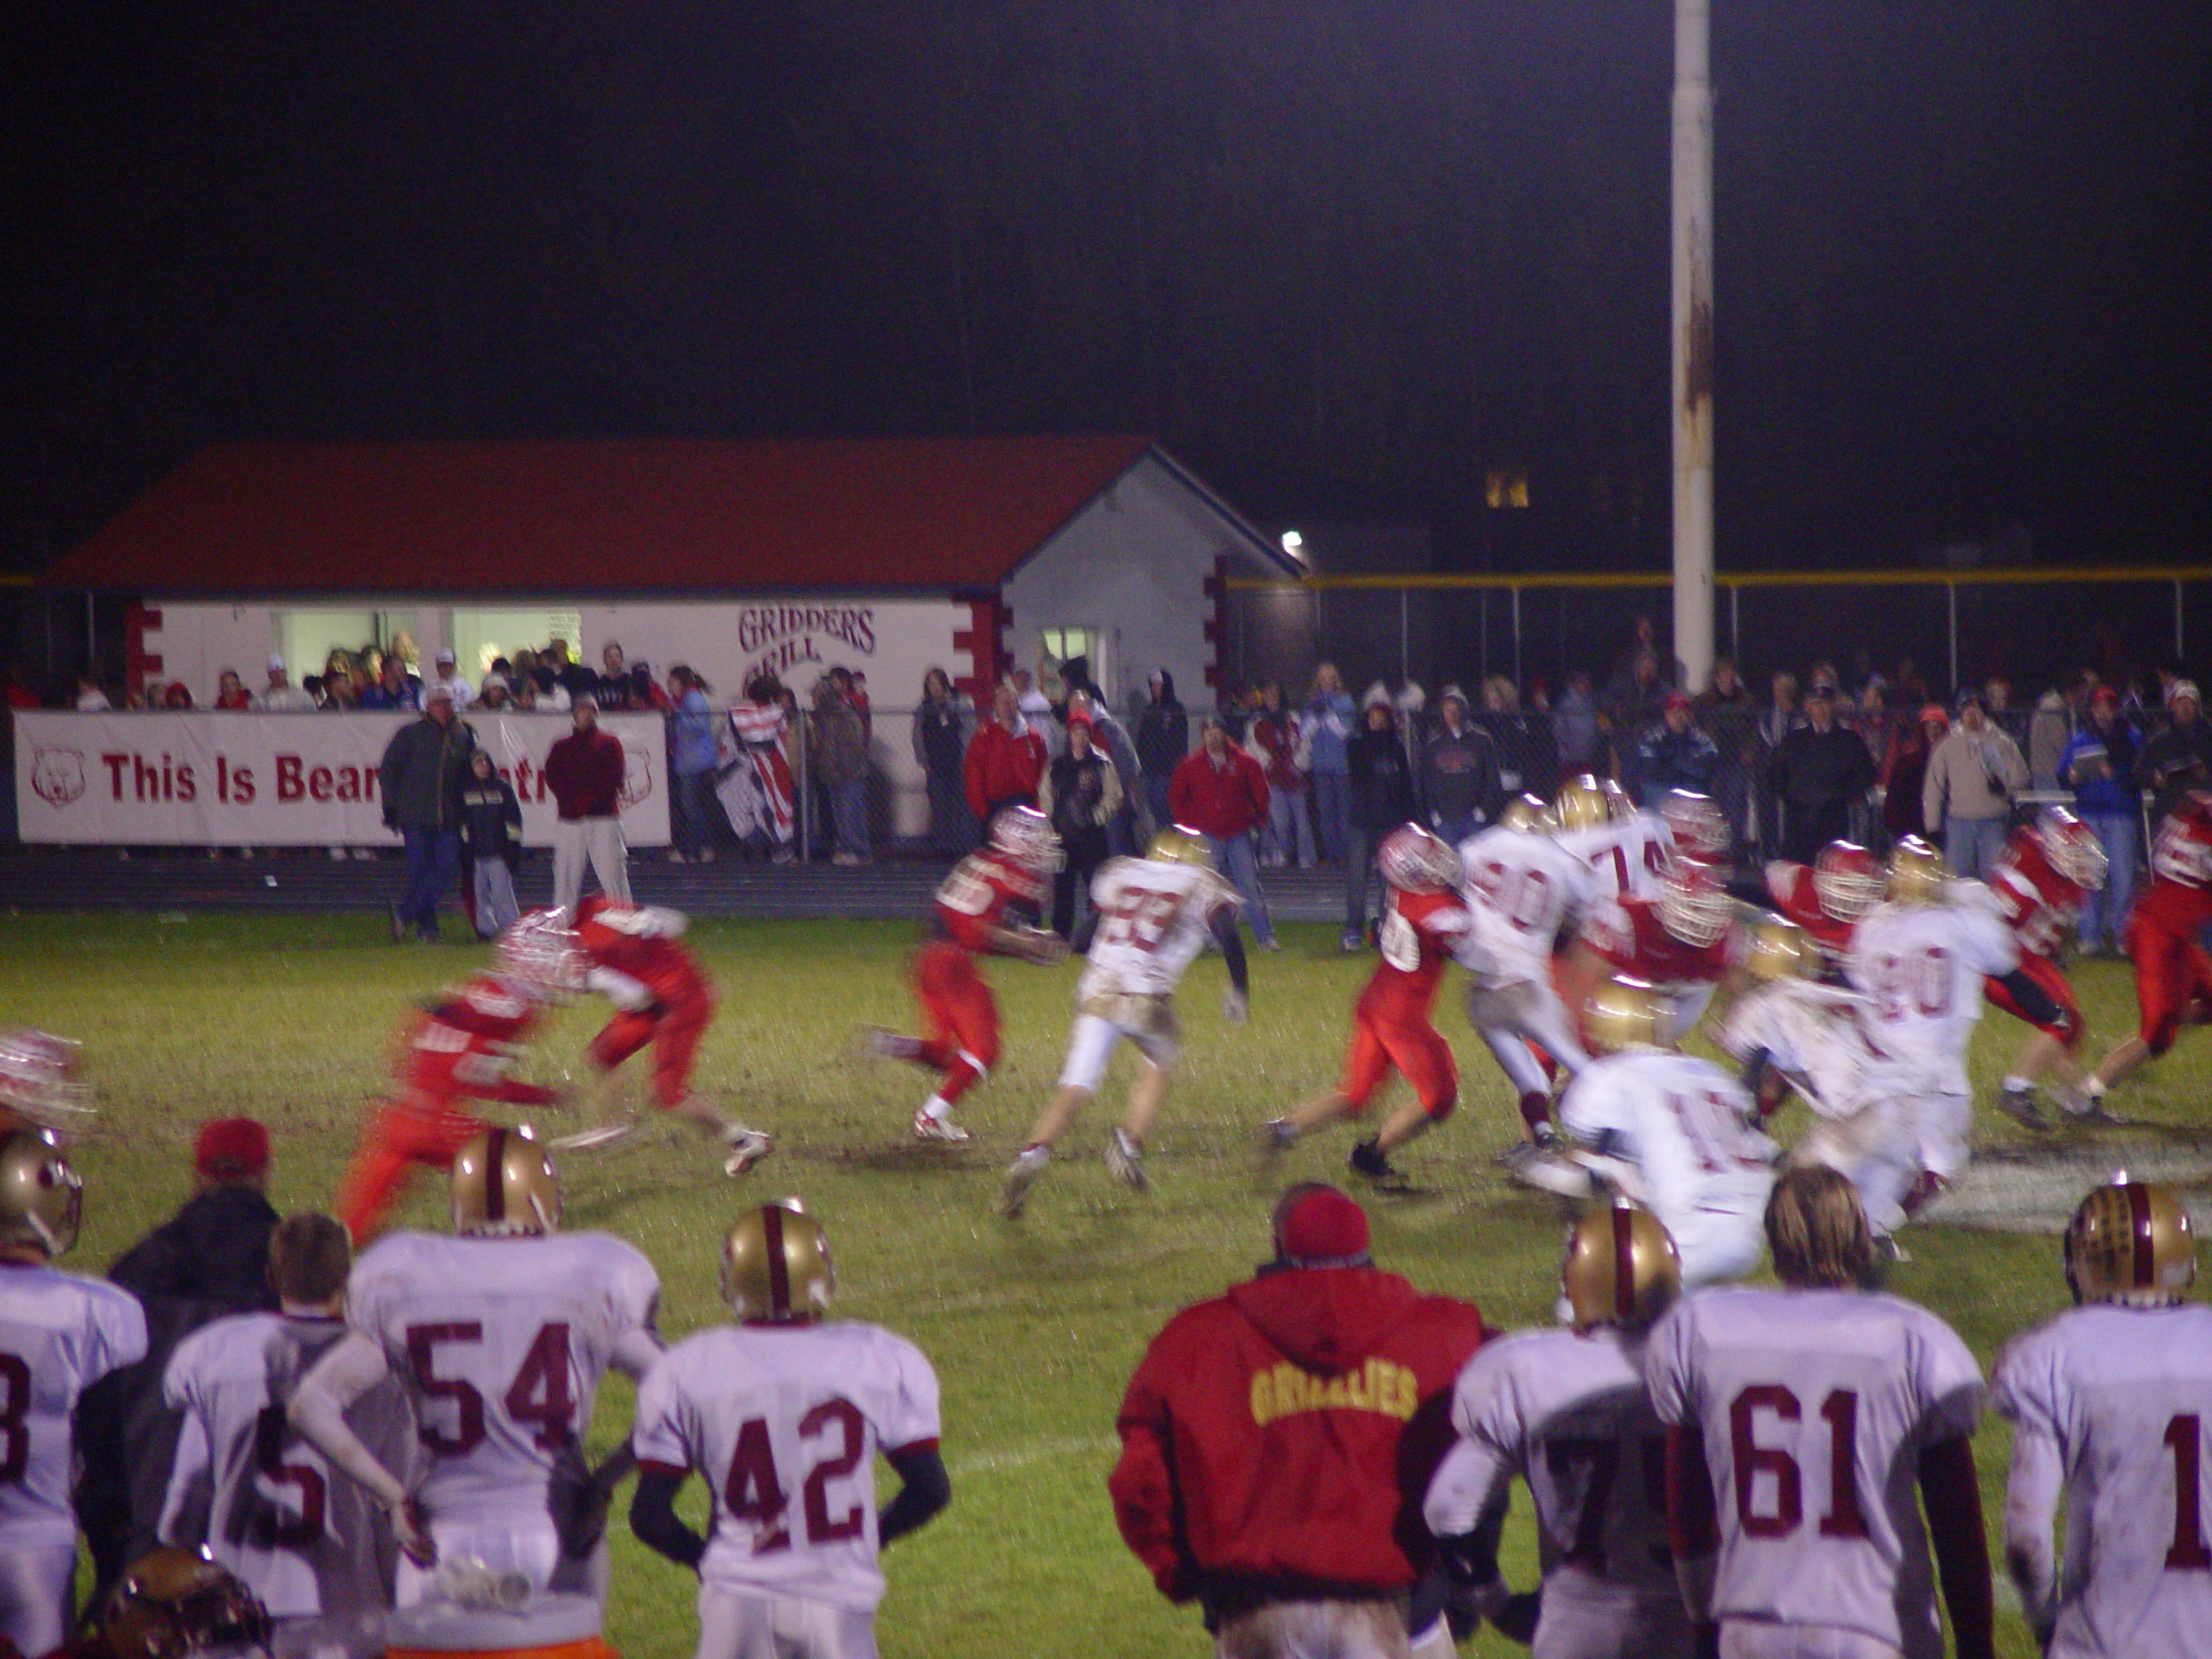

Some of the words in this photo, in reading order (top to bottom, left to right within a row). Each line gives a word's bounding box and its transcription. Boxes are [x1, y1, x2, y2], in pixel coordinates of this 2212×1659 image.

[740, 607, 875, 655] GRIDDERS
[102, 753, 197, 803] This
[216, 753, 256, 804] Is
[275, 754, 379, 804] Bear
[405, 1321, 576, 1459] 54
[724, 1396, 864, 1555] 42
[1730, 1384, 1870, 1539] 61
